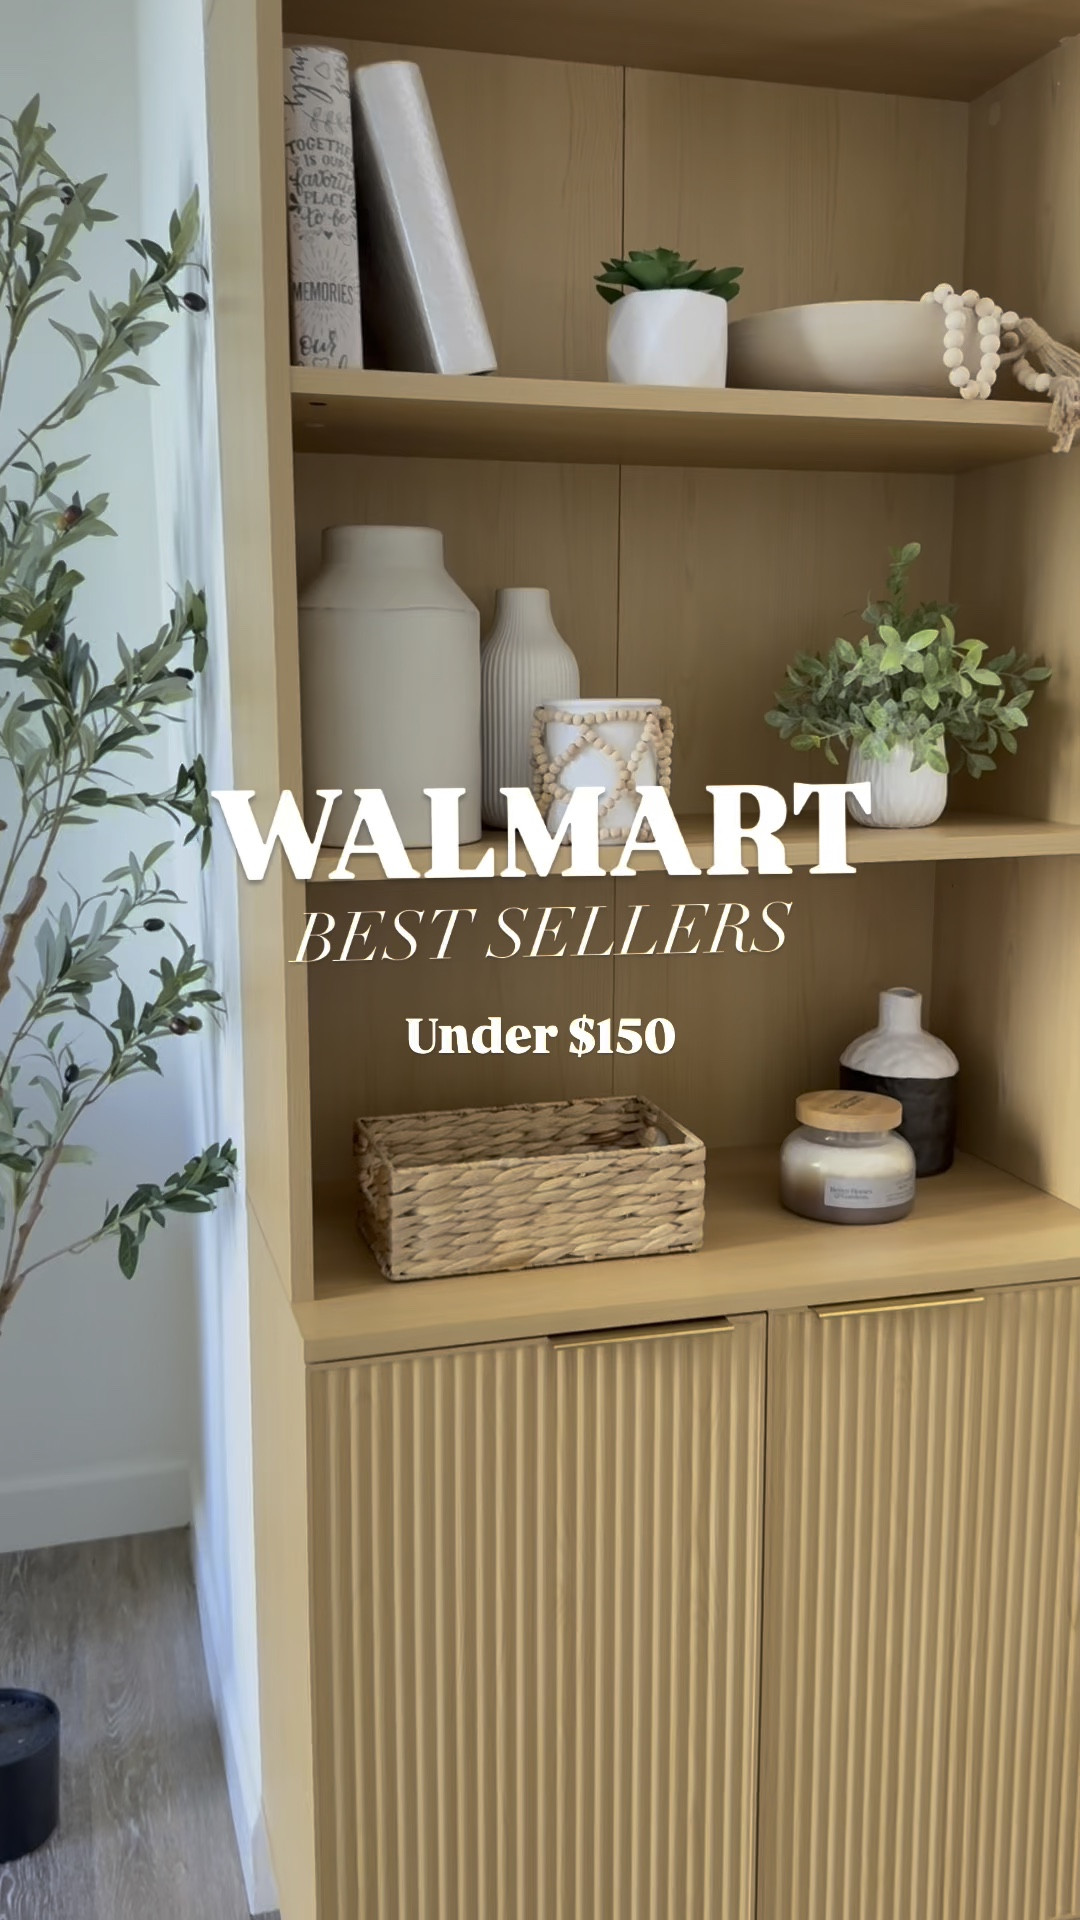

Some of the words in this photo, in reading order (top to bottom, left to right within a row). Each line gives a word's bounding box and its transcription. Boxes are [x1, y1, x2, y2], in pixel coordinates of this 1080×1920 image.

[285, 137, 353, 162] TOGETHE
[304, 191, 347, 208] PLACE
[300, 207, 326, 228] to
[293, 282, 354, 305] MEMORIES
